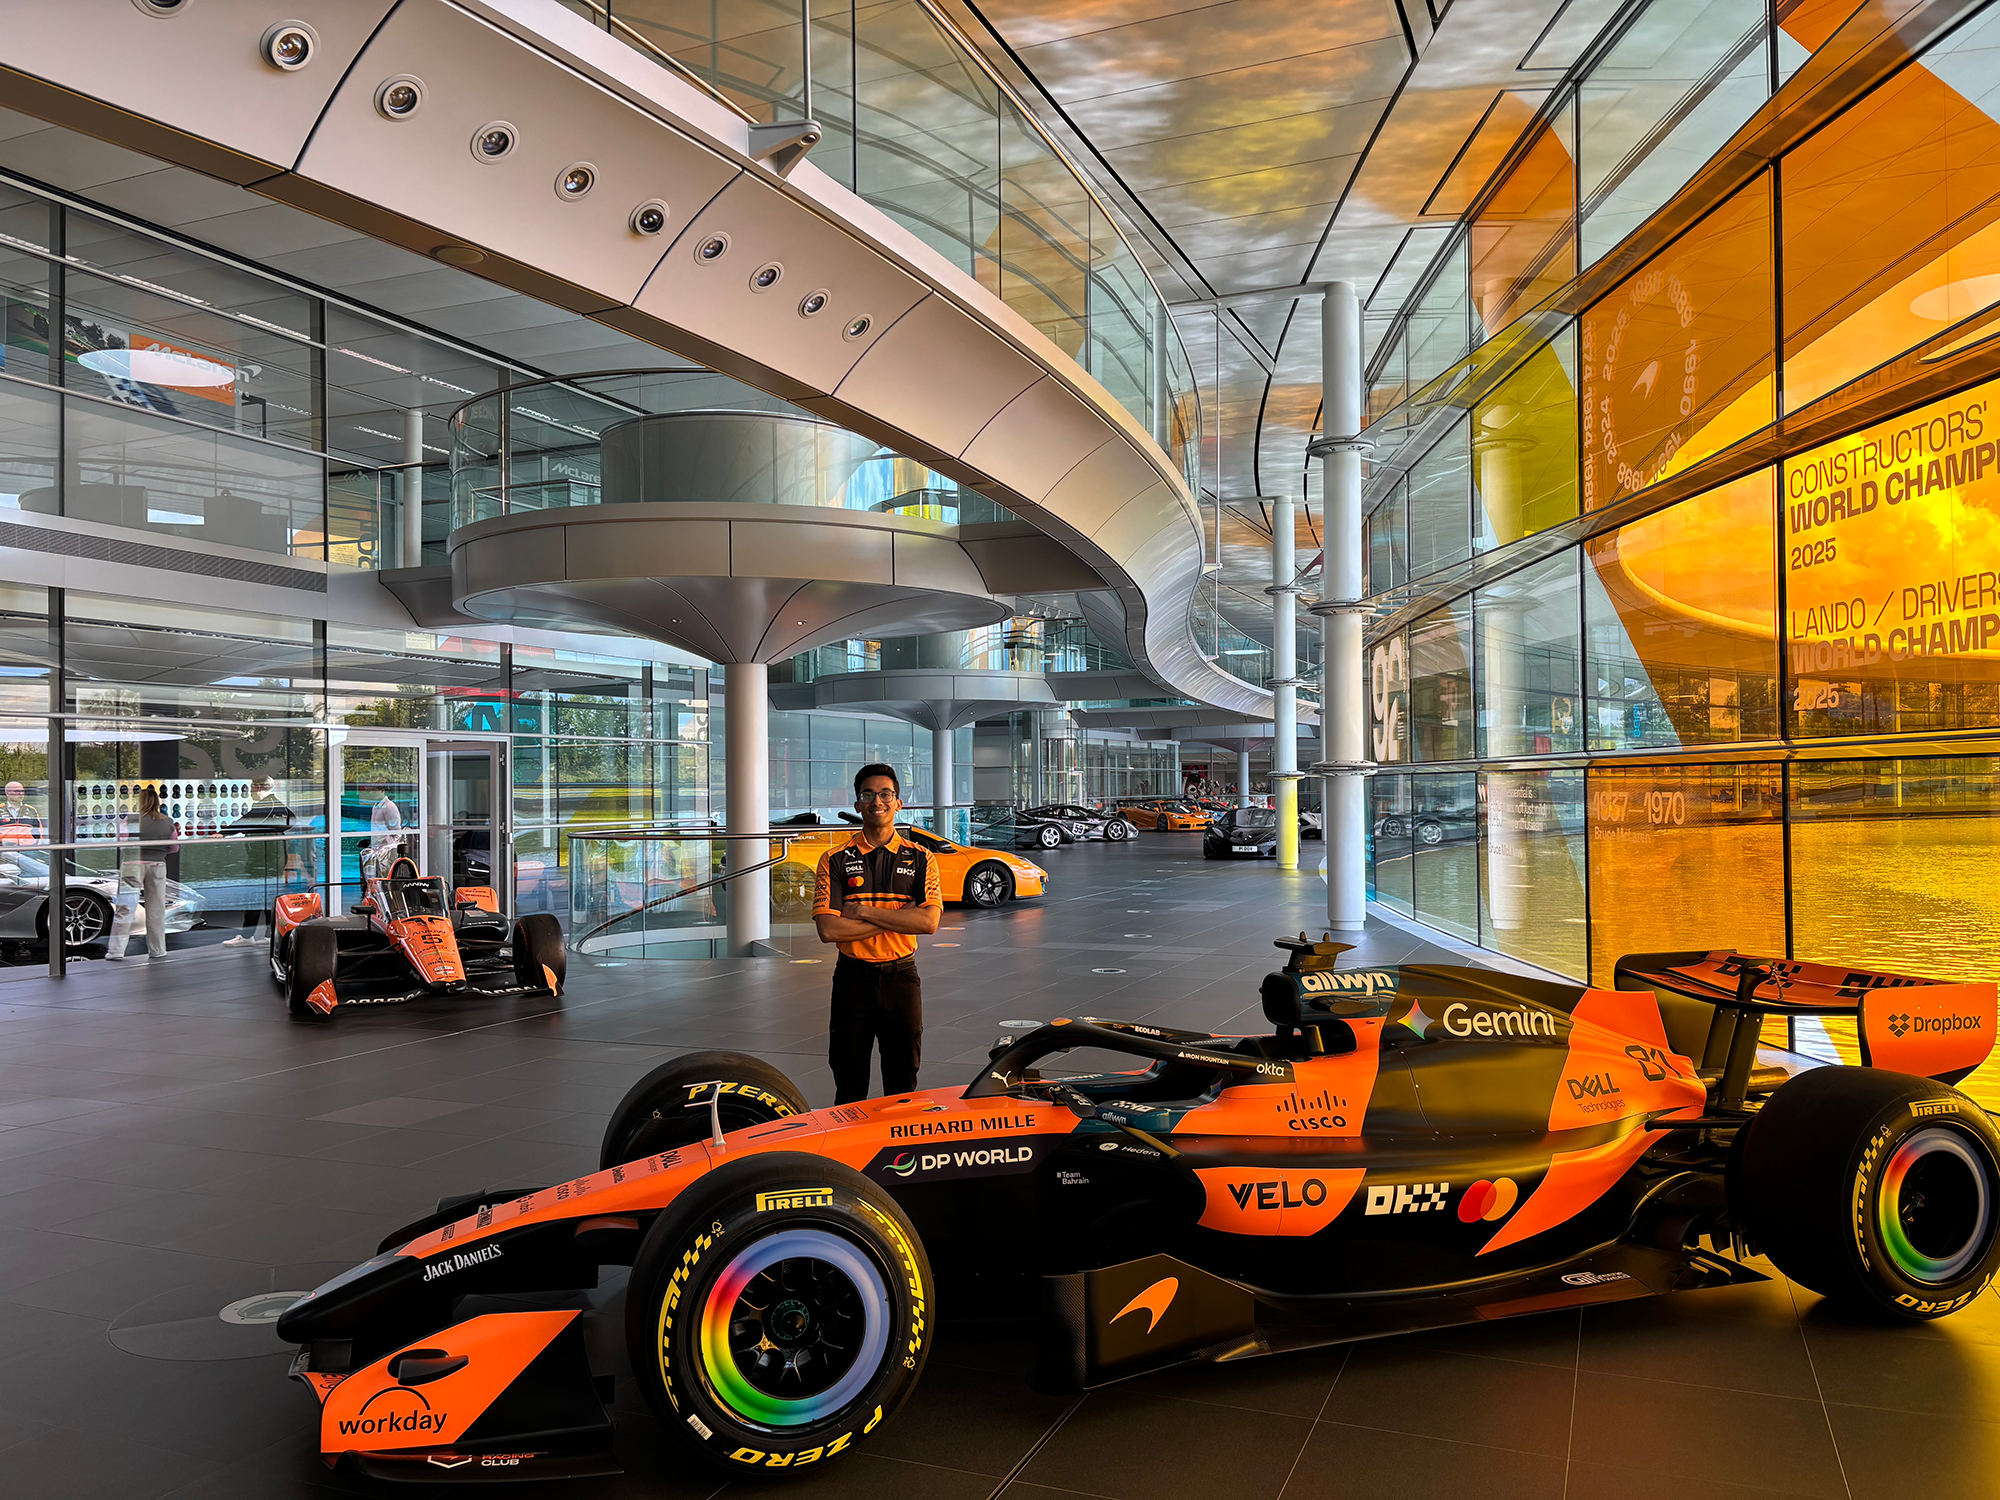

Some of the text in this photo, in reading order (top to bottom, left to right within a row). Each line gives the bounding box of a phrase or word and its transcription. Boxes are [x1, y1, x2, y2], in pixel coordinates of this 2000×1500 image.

[1630, 270, 1662, 307] 1988
[1667, 274, 1693, 328] 1989
[1679, 339, 1697, 417] 1990
[1789, 400, 1988, 499] CONSTRUCTORS'
[552, 462, 600, 484] McLare
[1790, 480, 1879, 534] WORLD
[1791, 537, 1837, 570] 2025
[1793, 597, 1866, 640] LANDO
[1902, 571, 2000, 621] DRIVER
[1793, 633, 1882, 675] WORLD
[1793, 683, 1840, 711] 2025
[421, 934, 443, 945] 5
[1301, 972, 1394, 996] allwyn
[1134, 1026, 1161, 1036] ECOLAB
[1442, 1002, 1557, 1037] Gemini
[1913, 1013, 1982, 1035] Dropbox
[1185, 1053, 1230, 1065] IRON MOUNTAIN
[1256, 1062, 1285, 1077] okta
[1625, 1045, 1684, 1081] 81
[1567, 1073, 1621, 1100] DELL
[1578, 1099, 1626, 1114] Technologies
[1908, 1099, 1960, 1117] PIRELLI
[890, 1114, 1036, 1139] RICHARD MILLE
[921, 1146, 1034, 1171] DP WORLD
[1062, 1177, 1089, 1185] Bahrain
[1227, 1178, 1328, 1211] VELO
[756, 1187, 834, 1212] PIRELLI
[1364, 1182, 1450, 1216] OKX
[339, 1410, 448, 1435] workday
[729, 1431, 853, 1468] ZERO
